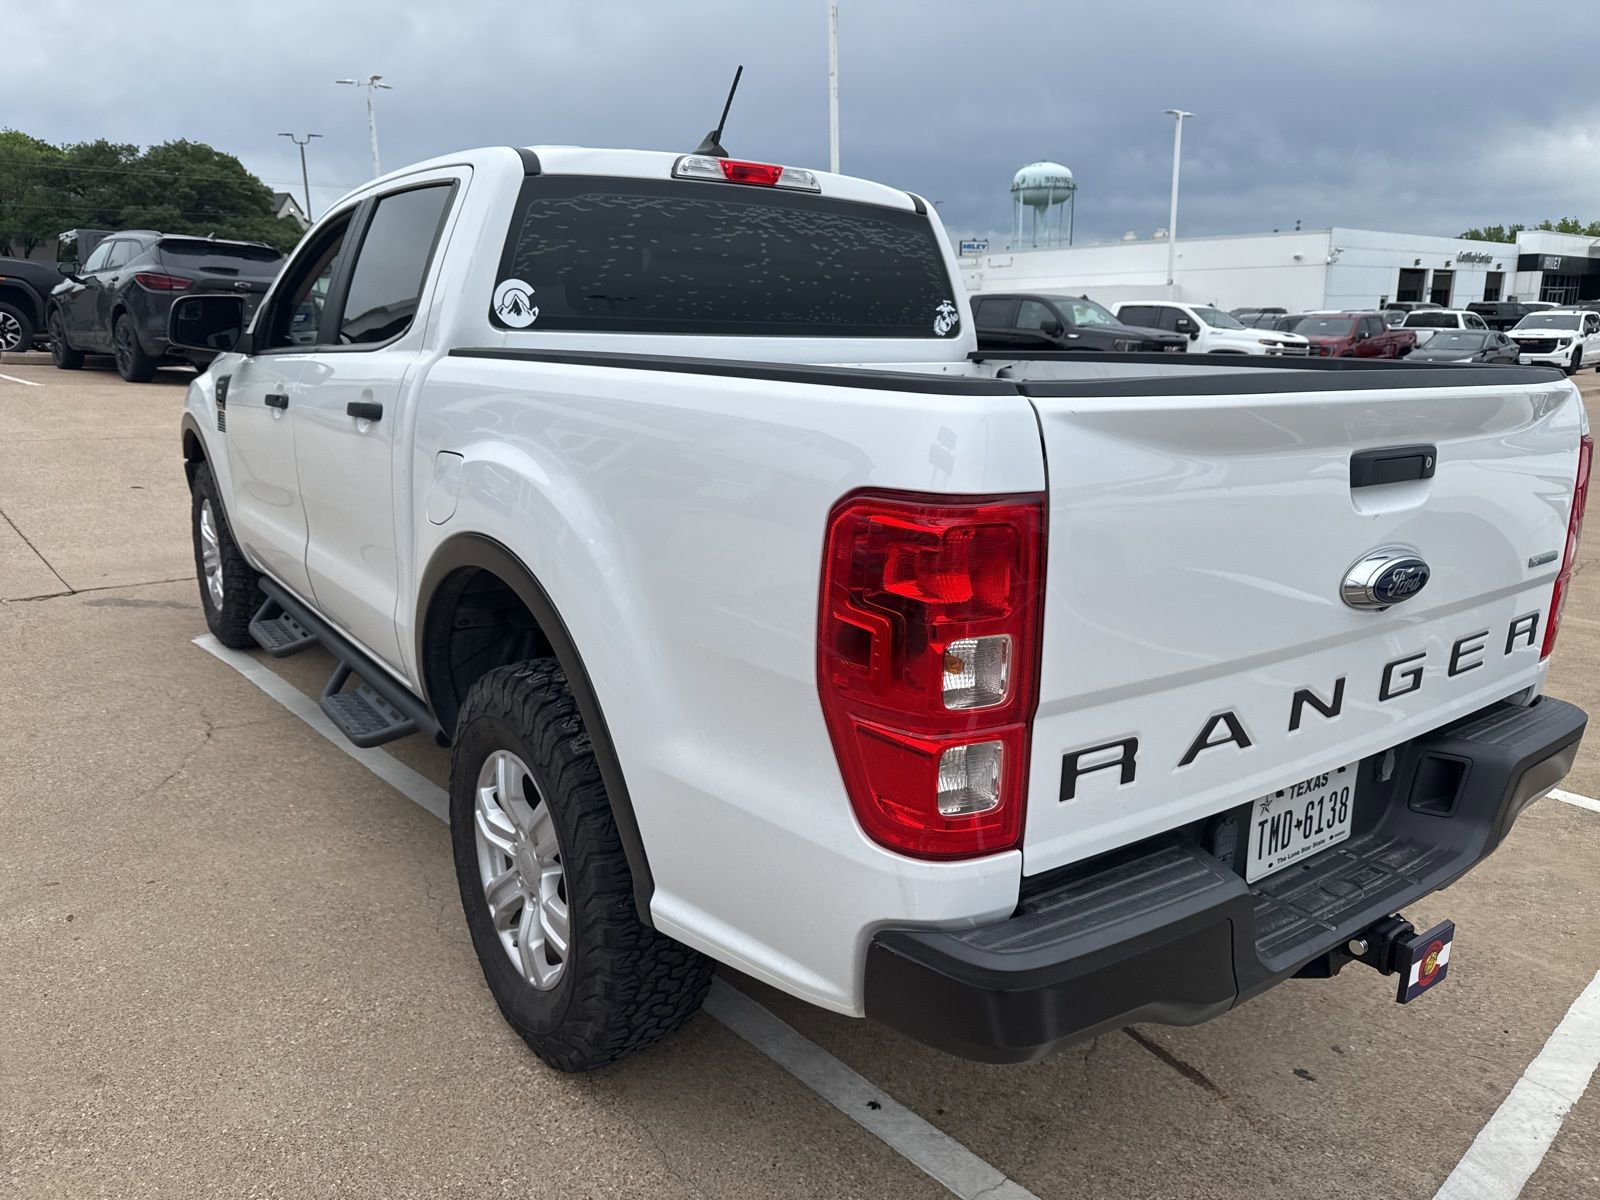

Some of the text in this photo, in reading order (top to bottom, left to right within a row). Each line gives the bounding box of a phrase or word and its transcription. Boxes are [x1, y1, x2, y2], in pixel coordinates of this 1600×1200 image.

[1388, 567, 1422, 597] Ford
[1059, 611, 1540, 802] RANGER
[1290, 772, 1330, 800] TEXAS
[1258, 786, 1350, 860] TMD 6138
[1277, 839, 1326, 864] The Lone Star State
